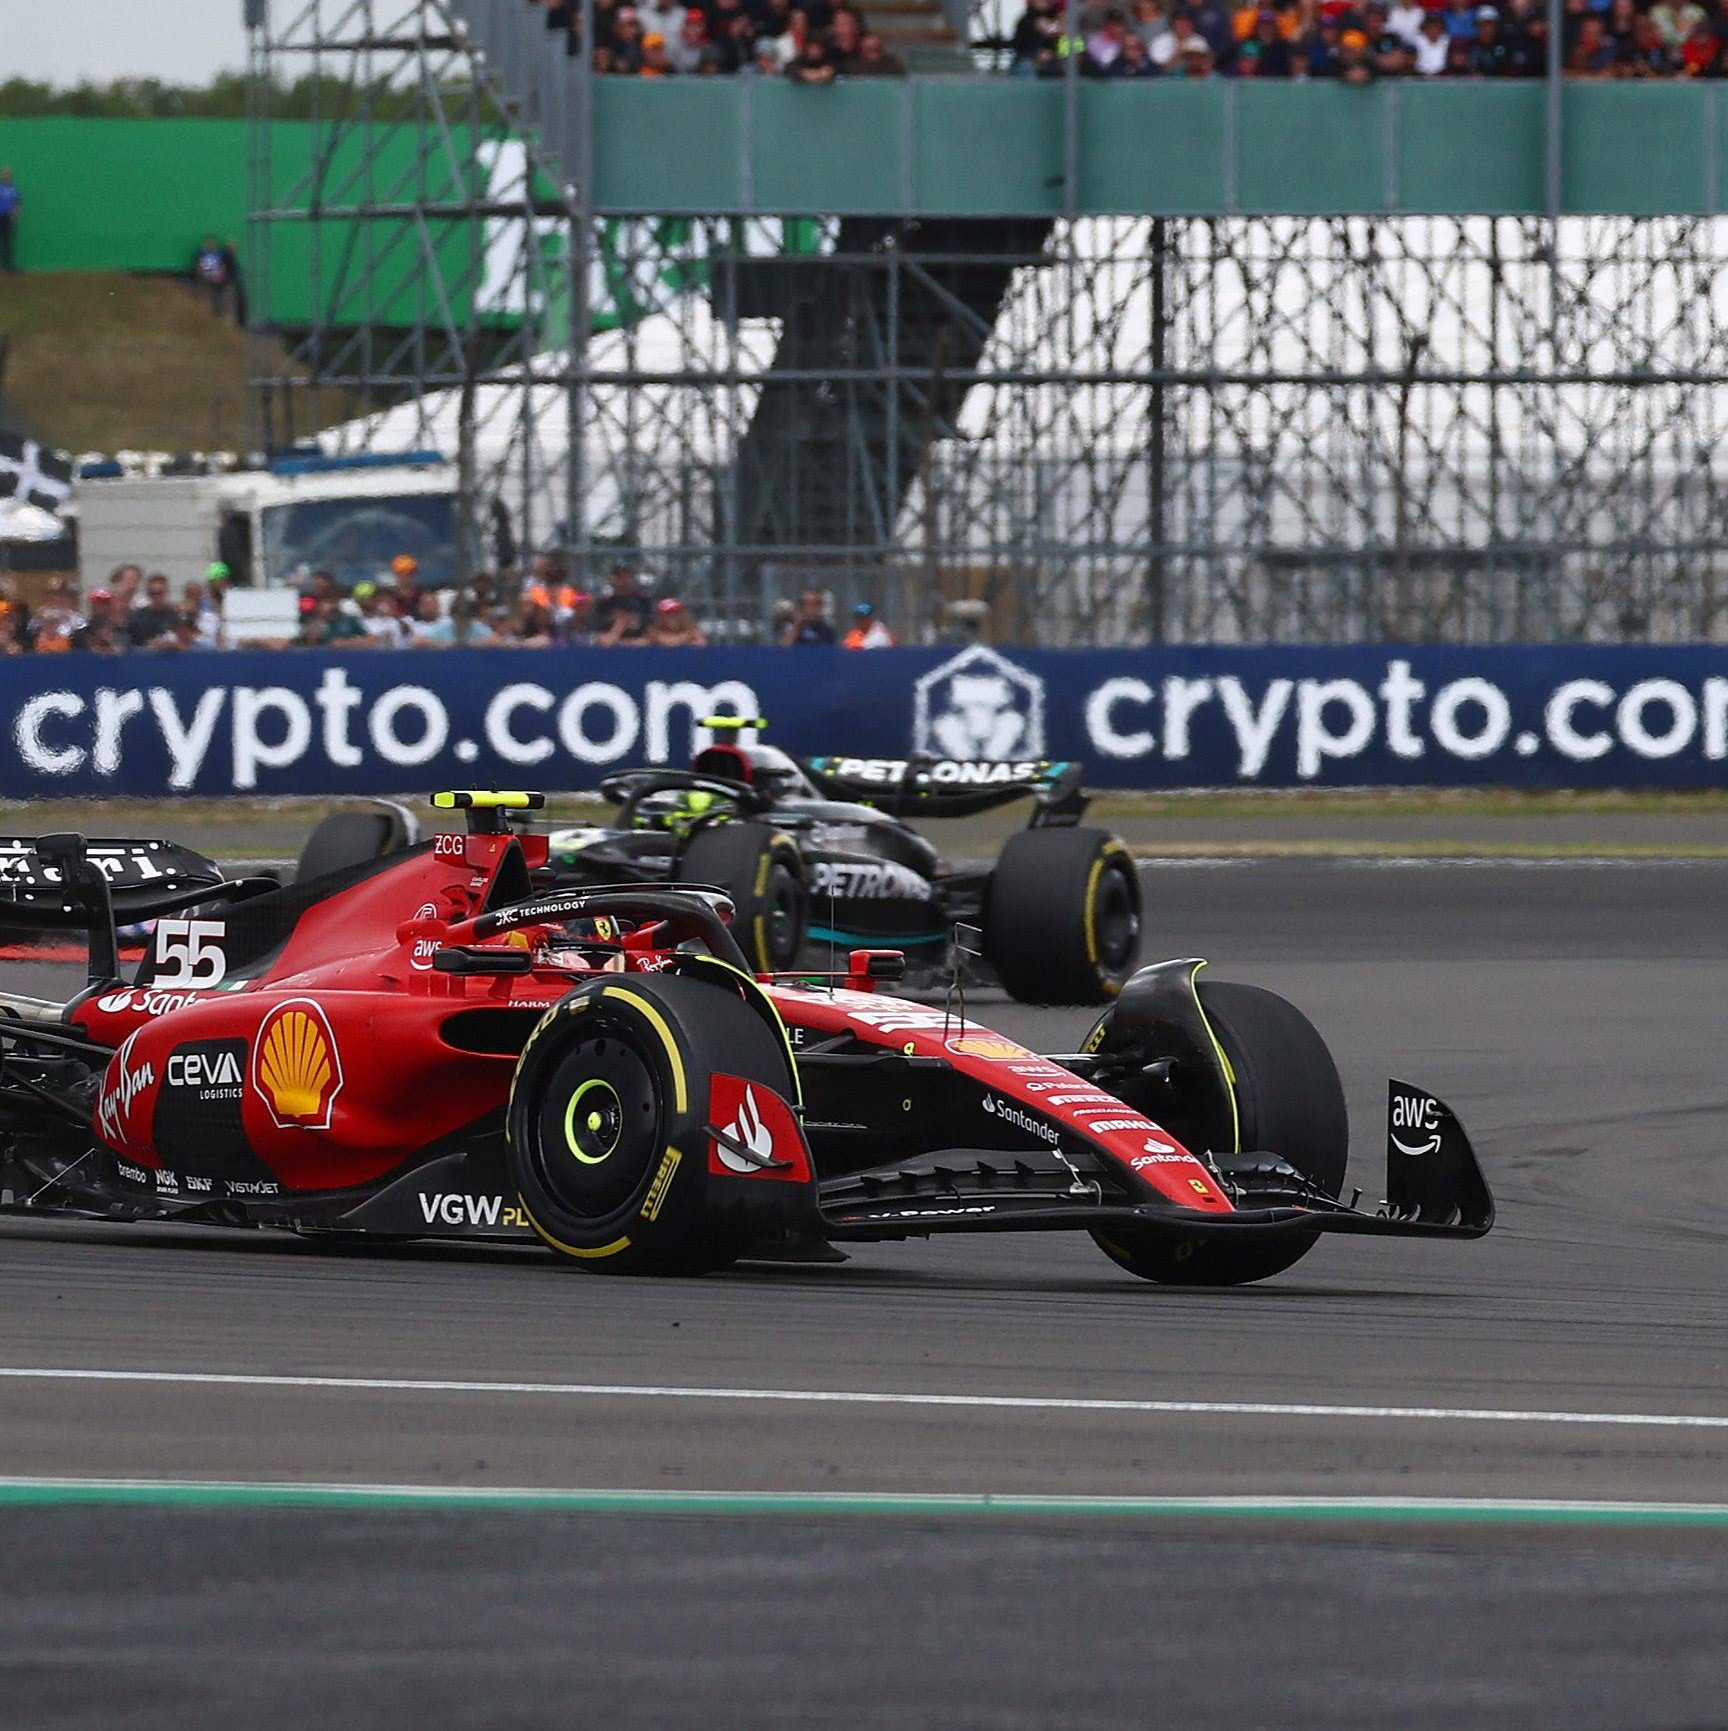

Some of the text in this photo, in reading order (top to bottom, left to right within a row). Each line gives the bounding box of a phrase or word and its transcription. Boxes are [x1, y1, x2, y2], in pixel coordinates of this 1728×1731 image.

[14, 667, 759, 789] crypto.com
[837, 758, 1036, 784] PETONAS
[435, 835, 463, 855] ZCG
[520, 900, 587, 918] TECHNOLOGY
[150, 918, 226, 989] 55
[200, 1087, 243, 1100] LOGISTICS
[996, 1099, 1061, 1146] Santander
[1393, 1095, 1439, 1130] aws
[117, 1161, 147, 1184] brembo
[155, 1169, 179, 1187] NGK
[185, 1175, 213, 1192] SKF
[419, 1192, 503, 1226] VGW
